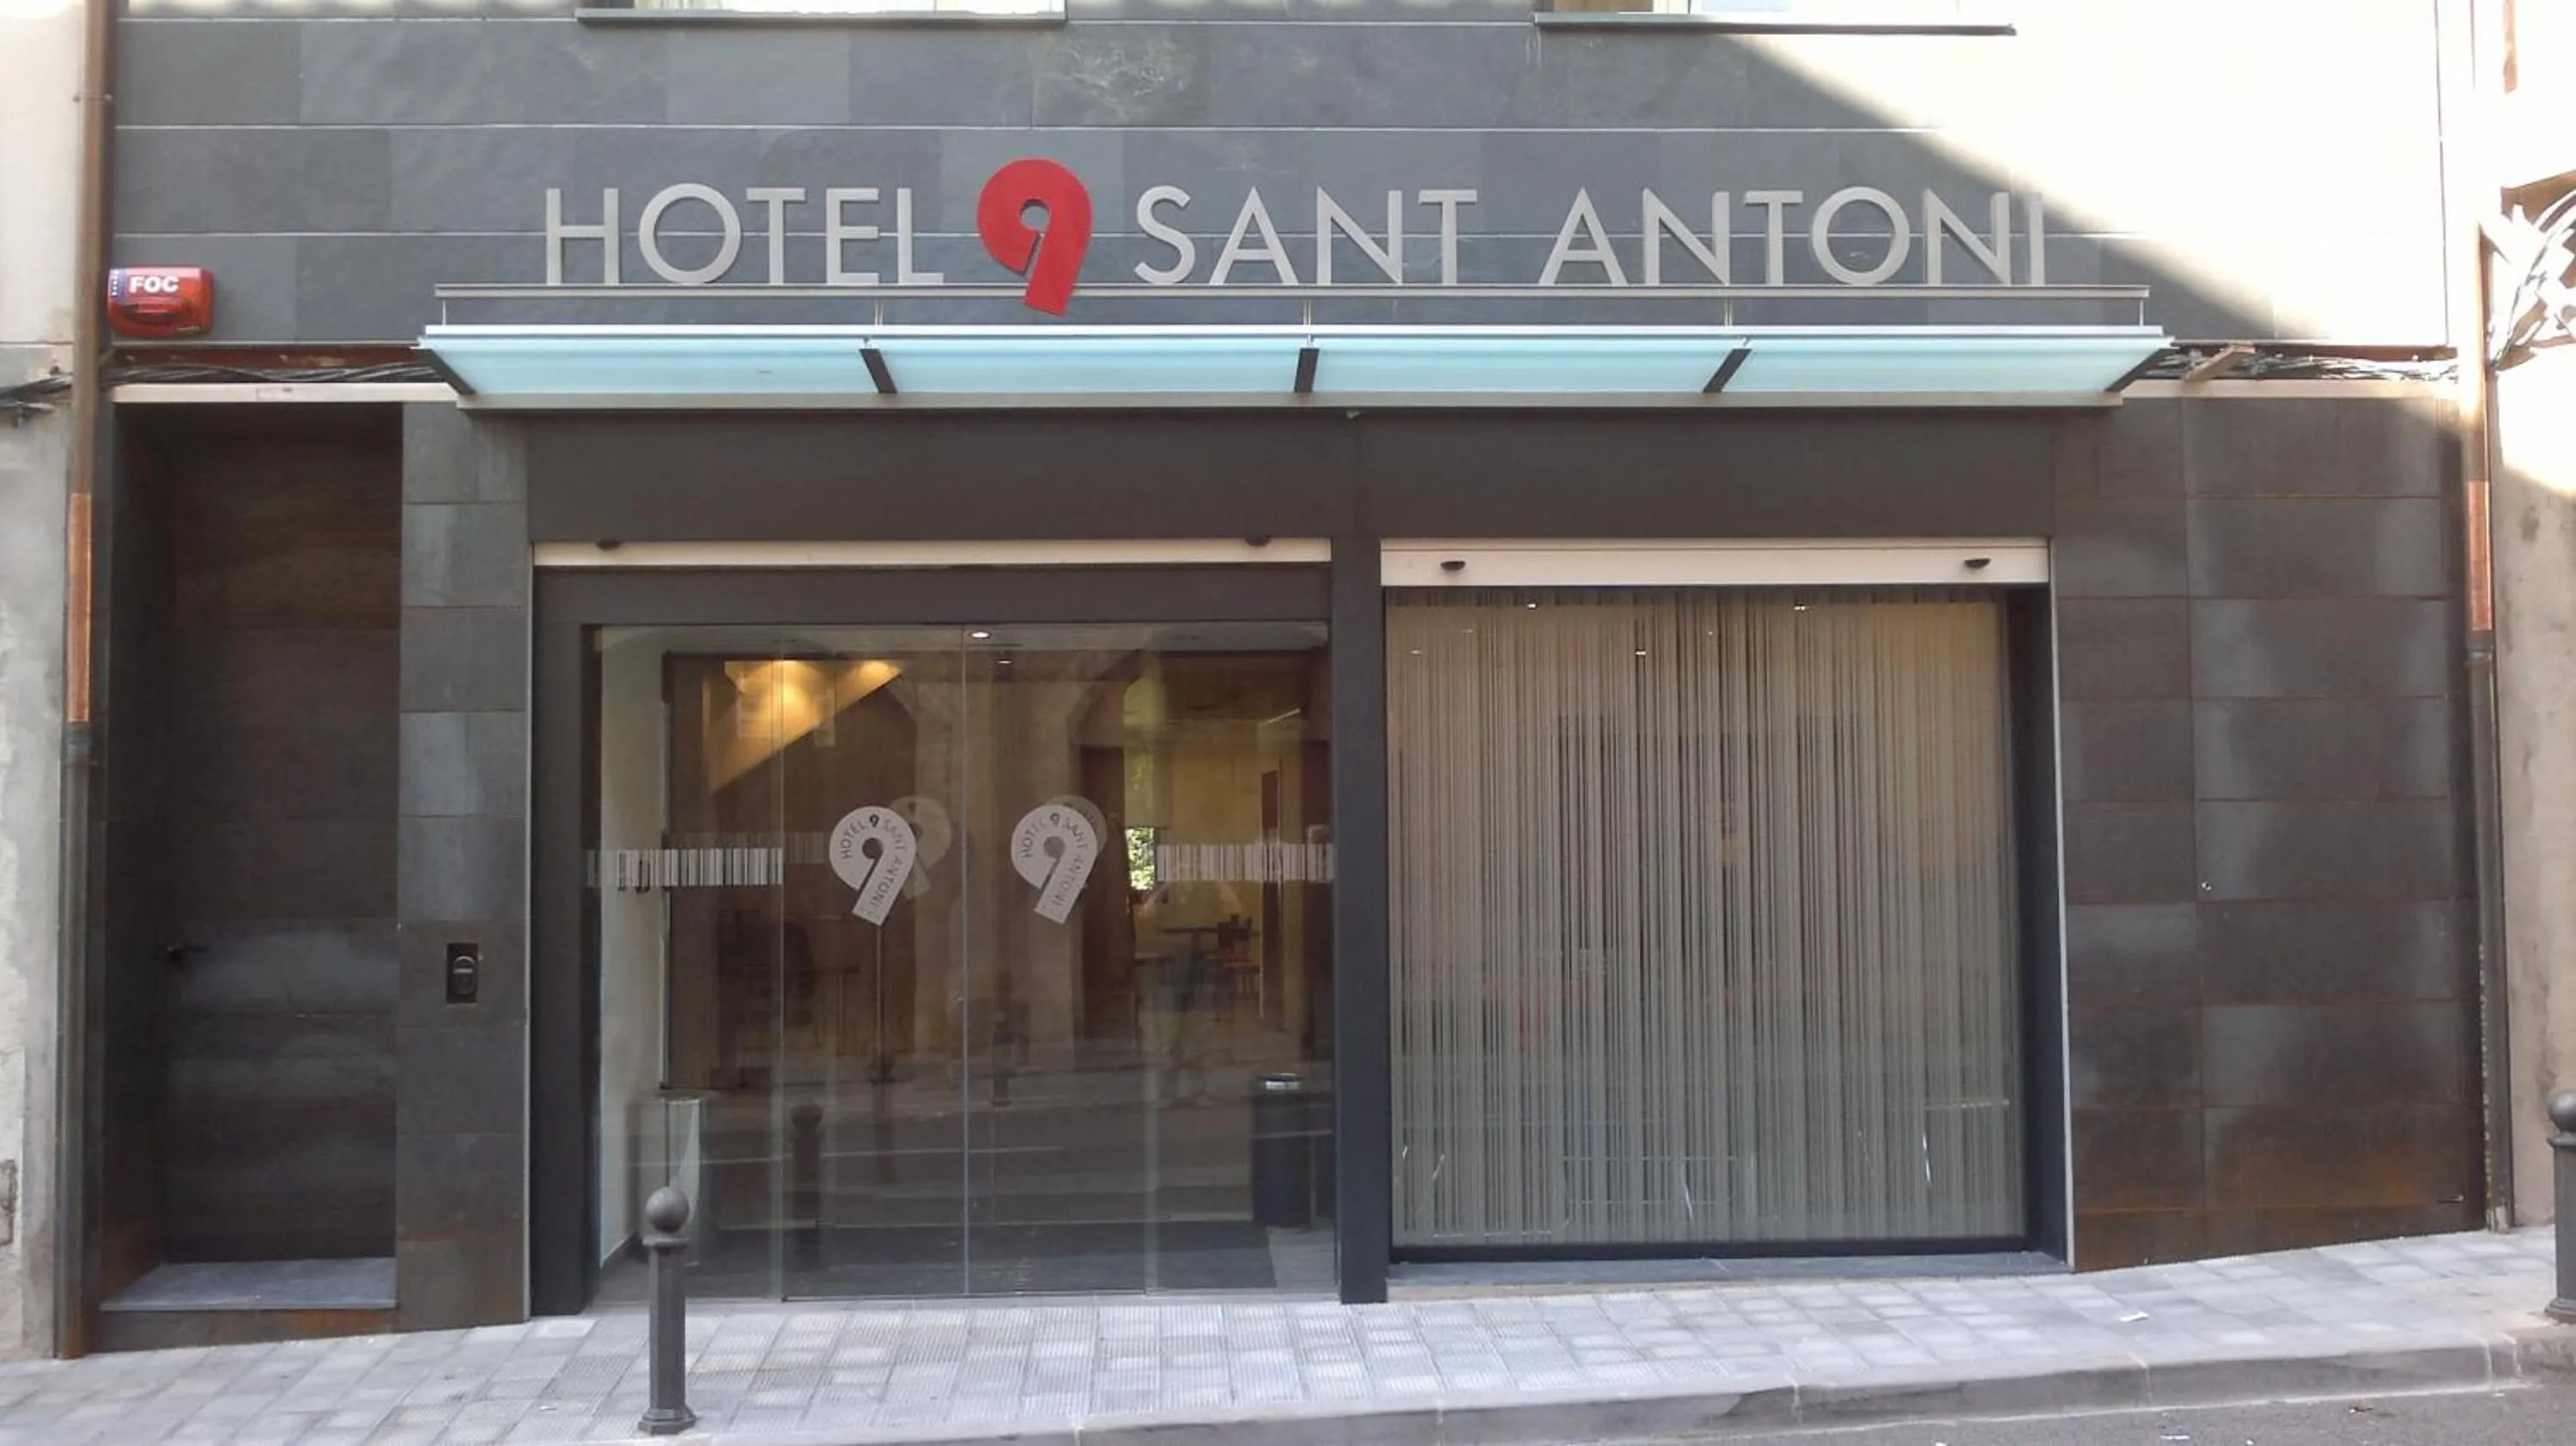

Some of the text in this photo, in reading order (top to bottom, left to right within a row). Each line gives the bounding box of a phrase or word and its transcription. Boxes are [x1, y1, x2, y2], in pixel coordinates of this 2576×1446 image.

[544, 158, 2046, 317] HOTEL 9 SANT ANTONI
[129, 275, 179, 293] FOC
[840, 819, 867, 860] HOTEL
